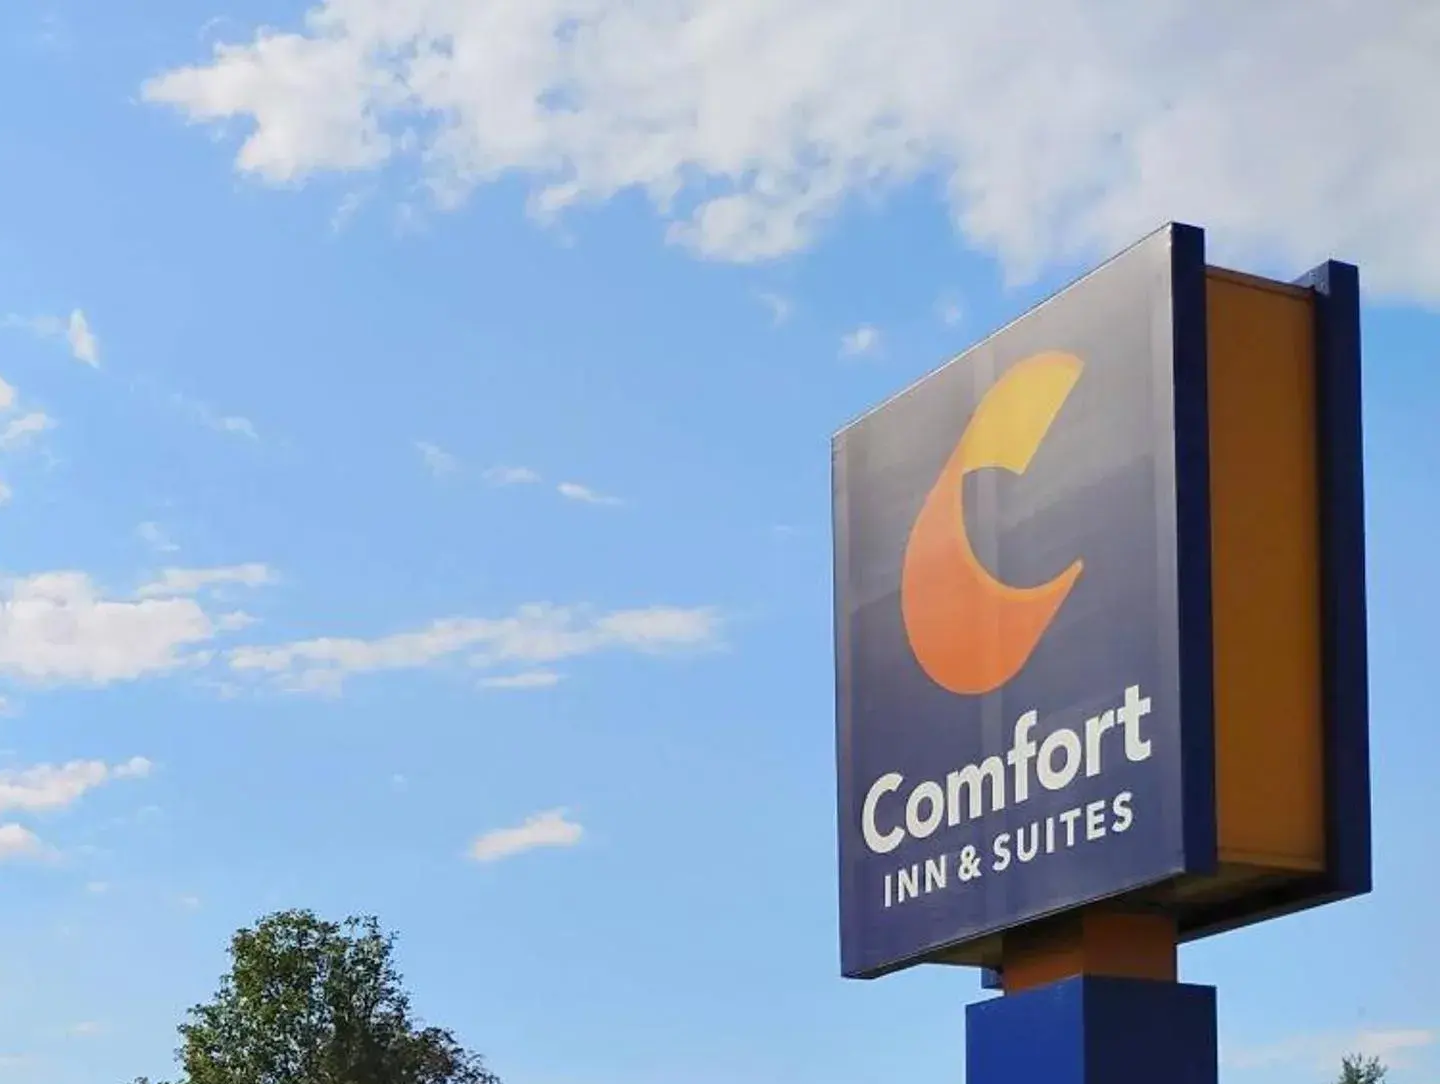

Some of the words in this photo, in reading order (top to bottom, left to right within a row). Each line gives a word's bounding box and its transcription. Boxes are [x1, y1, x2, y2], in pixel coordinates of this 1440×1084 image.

[862, 684, 1152, 853] Comfort
[883, 854, 947, 908] INN
[957, 844, 982, 882] &
[991, 791, 1133, 872] SUITES
